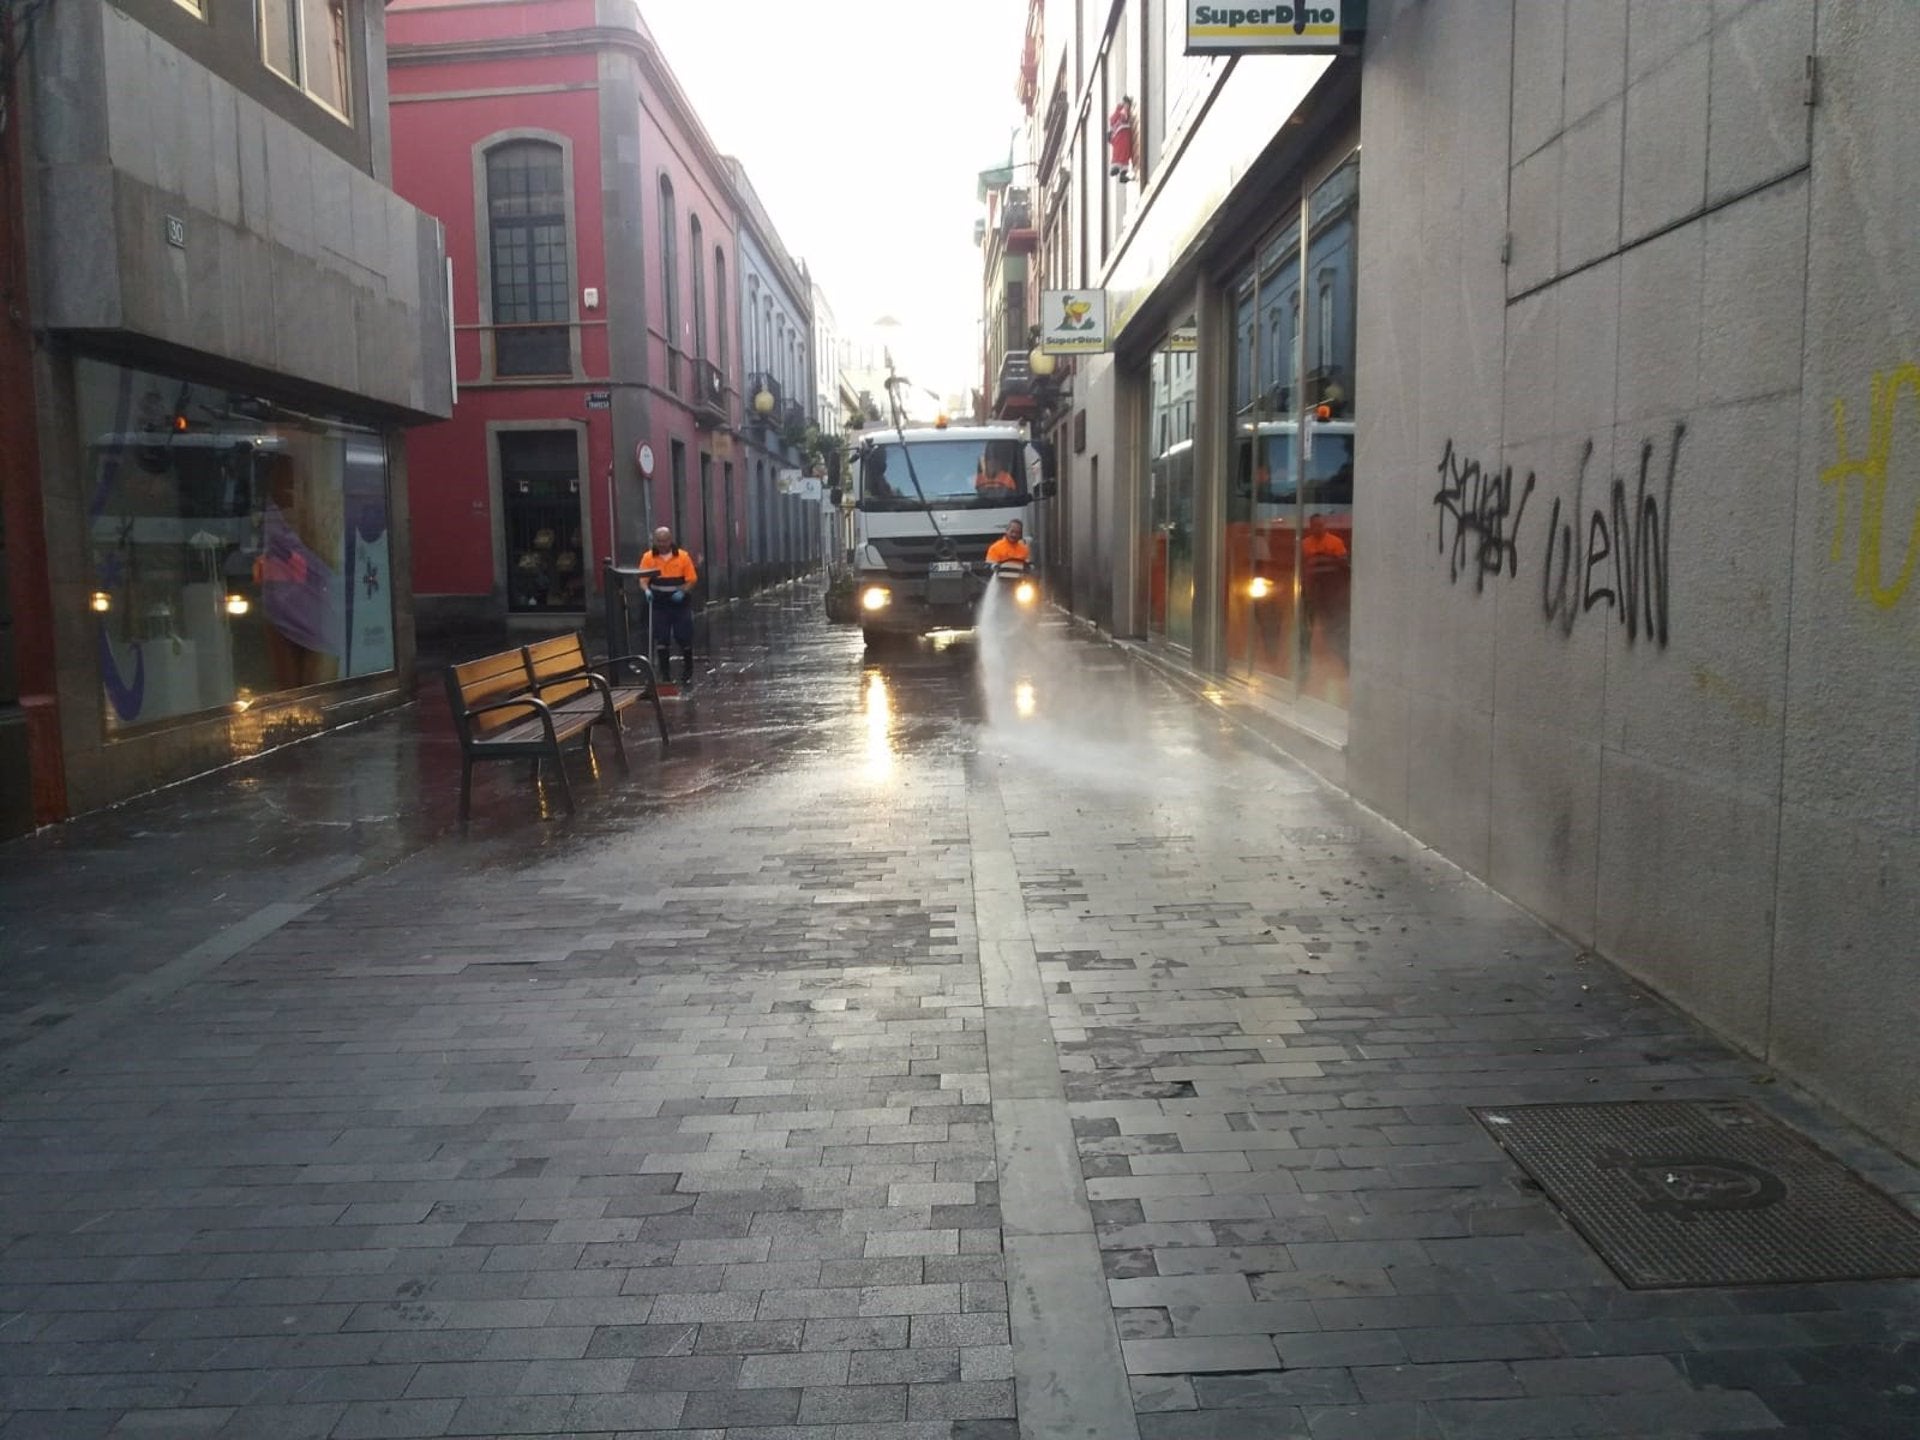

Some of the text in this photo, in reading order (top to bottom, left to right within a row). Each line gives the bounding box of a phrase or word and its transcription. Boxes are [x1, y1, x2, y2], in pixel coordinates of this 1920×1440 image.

[1195, 5, 1336, 28] SuperDno
[170, 220, 183, 243] 30
[1046, 335, 1103, 346] SuperDino
